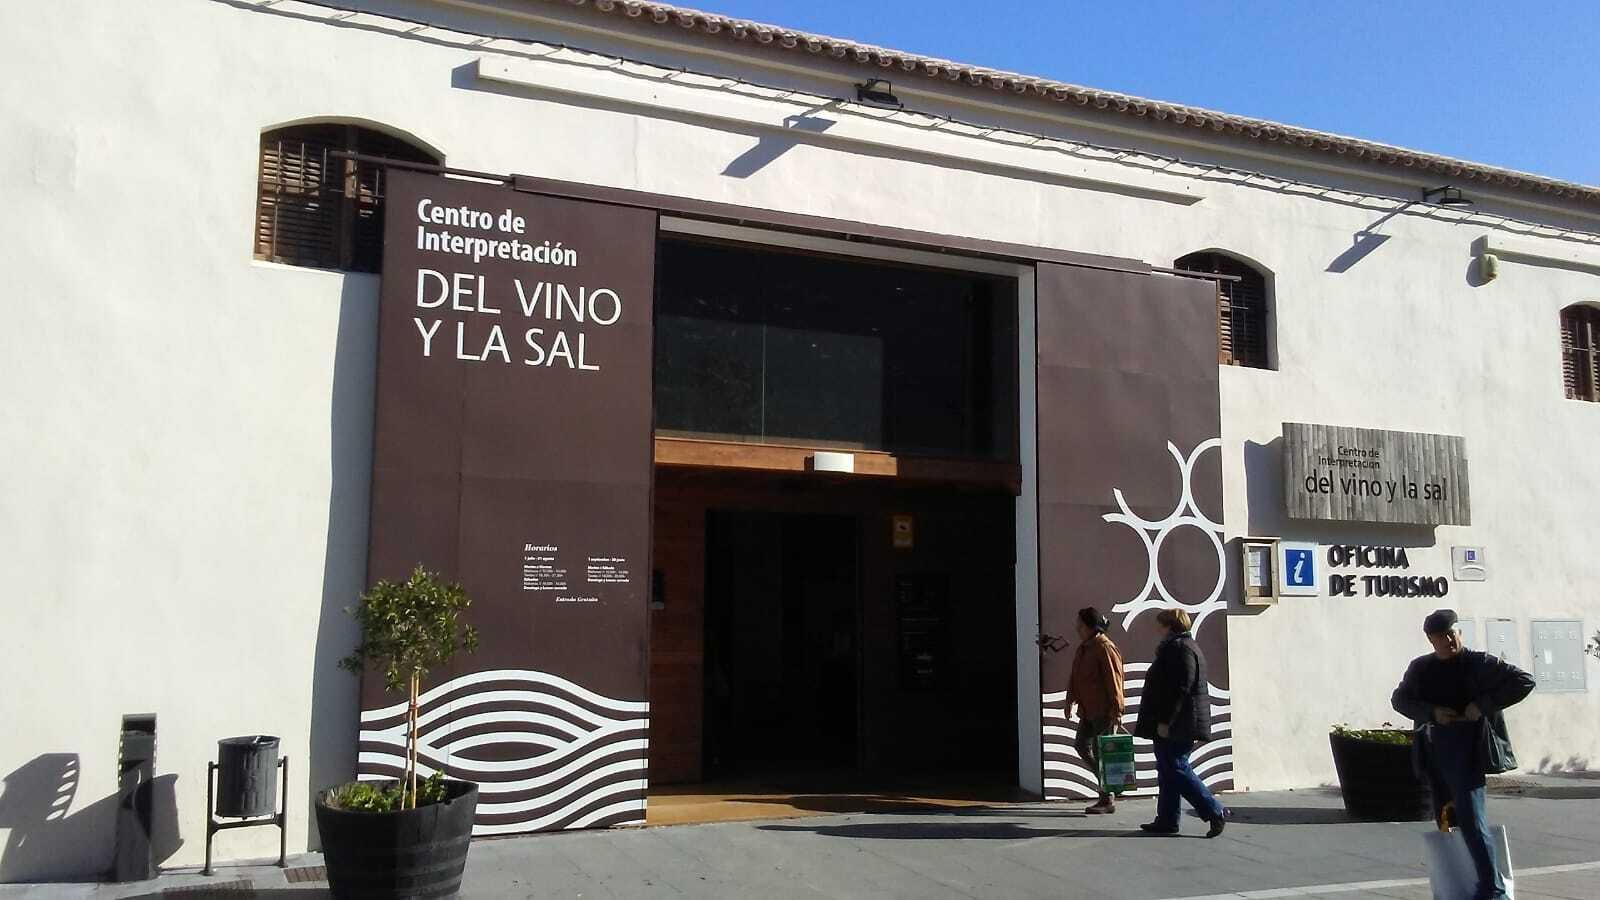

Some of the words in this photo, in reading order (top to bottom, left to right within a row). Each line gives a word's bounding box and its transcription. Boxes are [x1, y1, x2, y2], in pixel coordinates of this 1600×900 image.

[417, 198, 494, 230] Centro
[498, 209, 526, 233] de
[417, 225, 578, 267] Interpretación
[416, 269, 502, 314] DEL
[514, 279, 622, 325] VINO
[414, 317, 443, 357] Y
[456, 321, 511, 364] LA
[524, 328, 600, 371] SAL
[1337, 446, 1367, 458] Centro
[1368, 448, 1380, 458] de
[1305, 469, 1334, 494] del
[1340, 473, 1382, 497] vino
[1385, 479, 1397, 504] y
[1402, 475, 1418, 500] la
[1423, 477, 1447, 501] sal
[1326, 545, 1410, 570] OFICINA
[1328, 574, 1357, 597] DE
[1361, 575, 1449, 598] TURISMO
